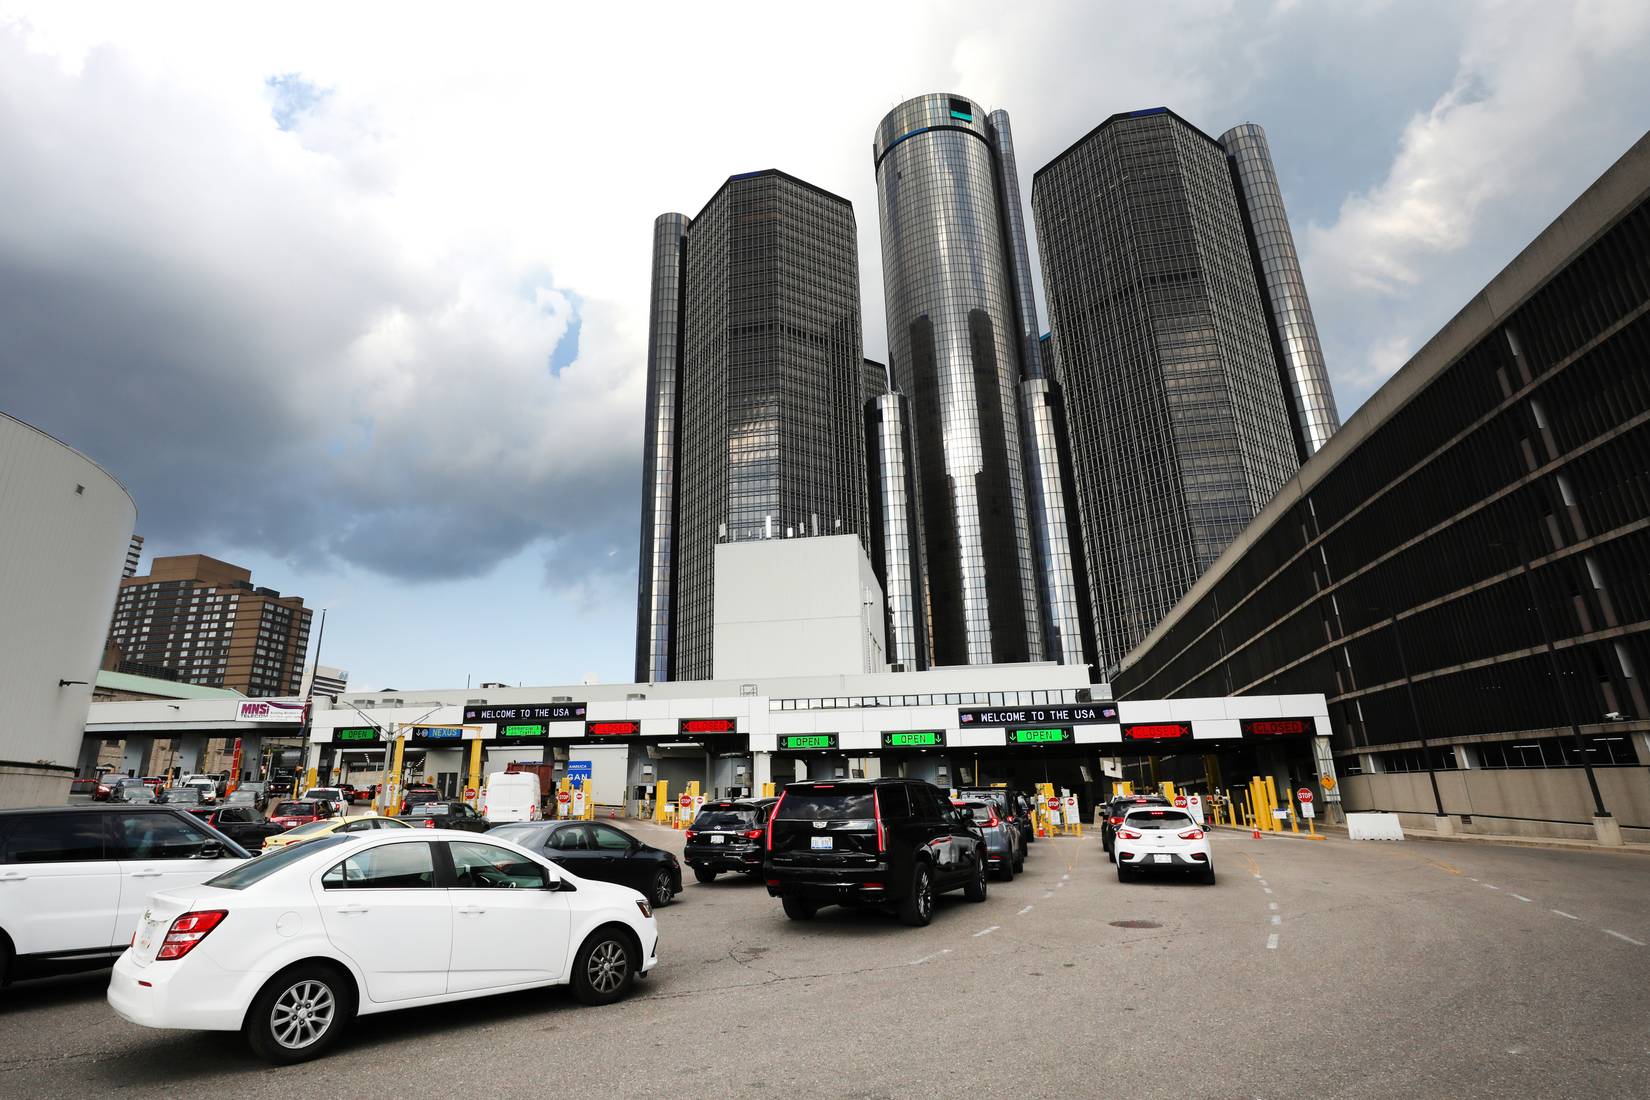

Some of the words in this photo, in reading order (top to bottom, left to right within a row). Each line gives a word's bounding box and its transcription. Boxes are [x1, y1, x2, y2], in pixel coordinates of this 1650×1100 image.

[481, 709, 516, 719] WELCOME
[520, 709, 531, 718] TO
[534, 708, 550, 717] THE
[553, 707, 570, 717] USA
[981, 712, 1026, 722] WELCOME
[1031, 711, 1045, 721] TO
[1050, 710, 1070, 720] THE
[1074, 709, 1096, 719] USA
[1136, 726, 1177, 737] CLOSED
[1256, 722, 1299, 732] CLOSED
[348, 730, 368, 739] OPEN
[432, 728, 458, 737] NEXUS
[1026, 731, 1053, 741] OPEN
[796, 737, 820, 746] OPEN
[901, 734, 926, 744] OPEN
